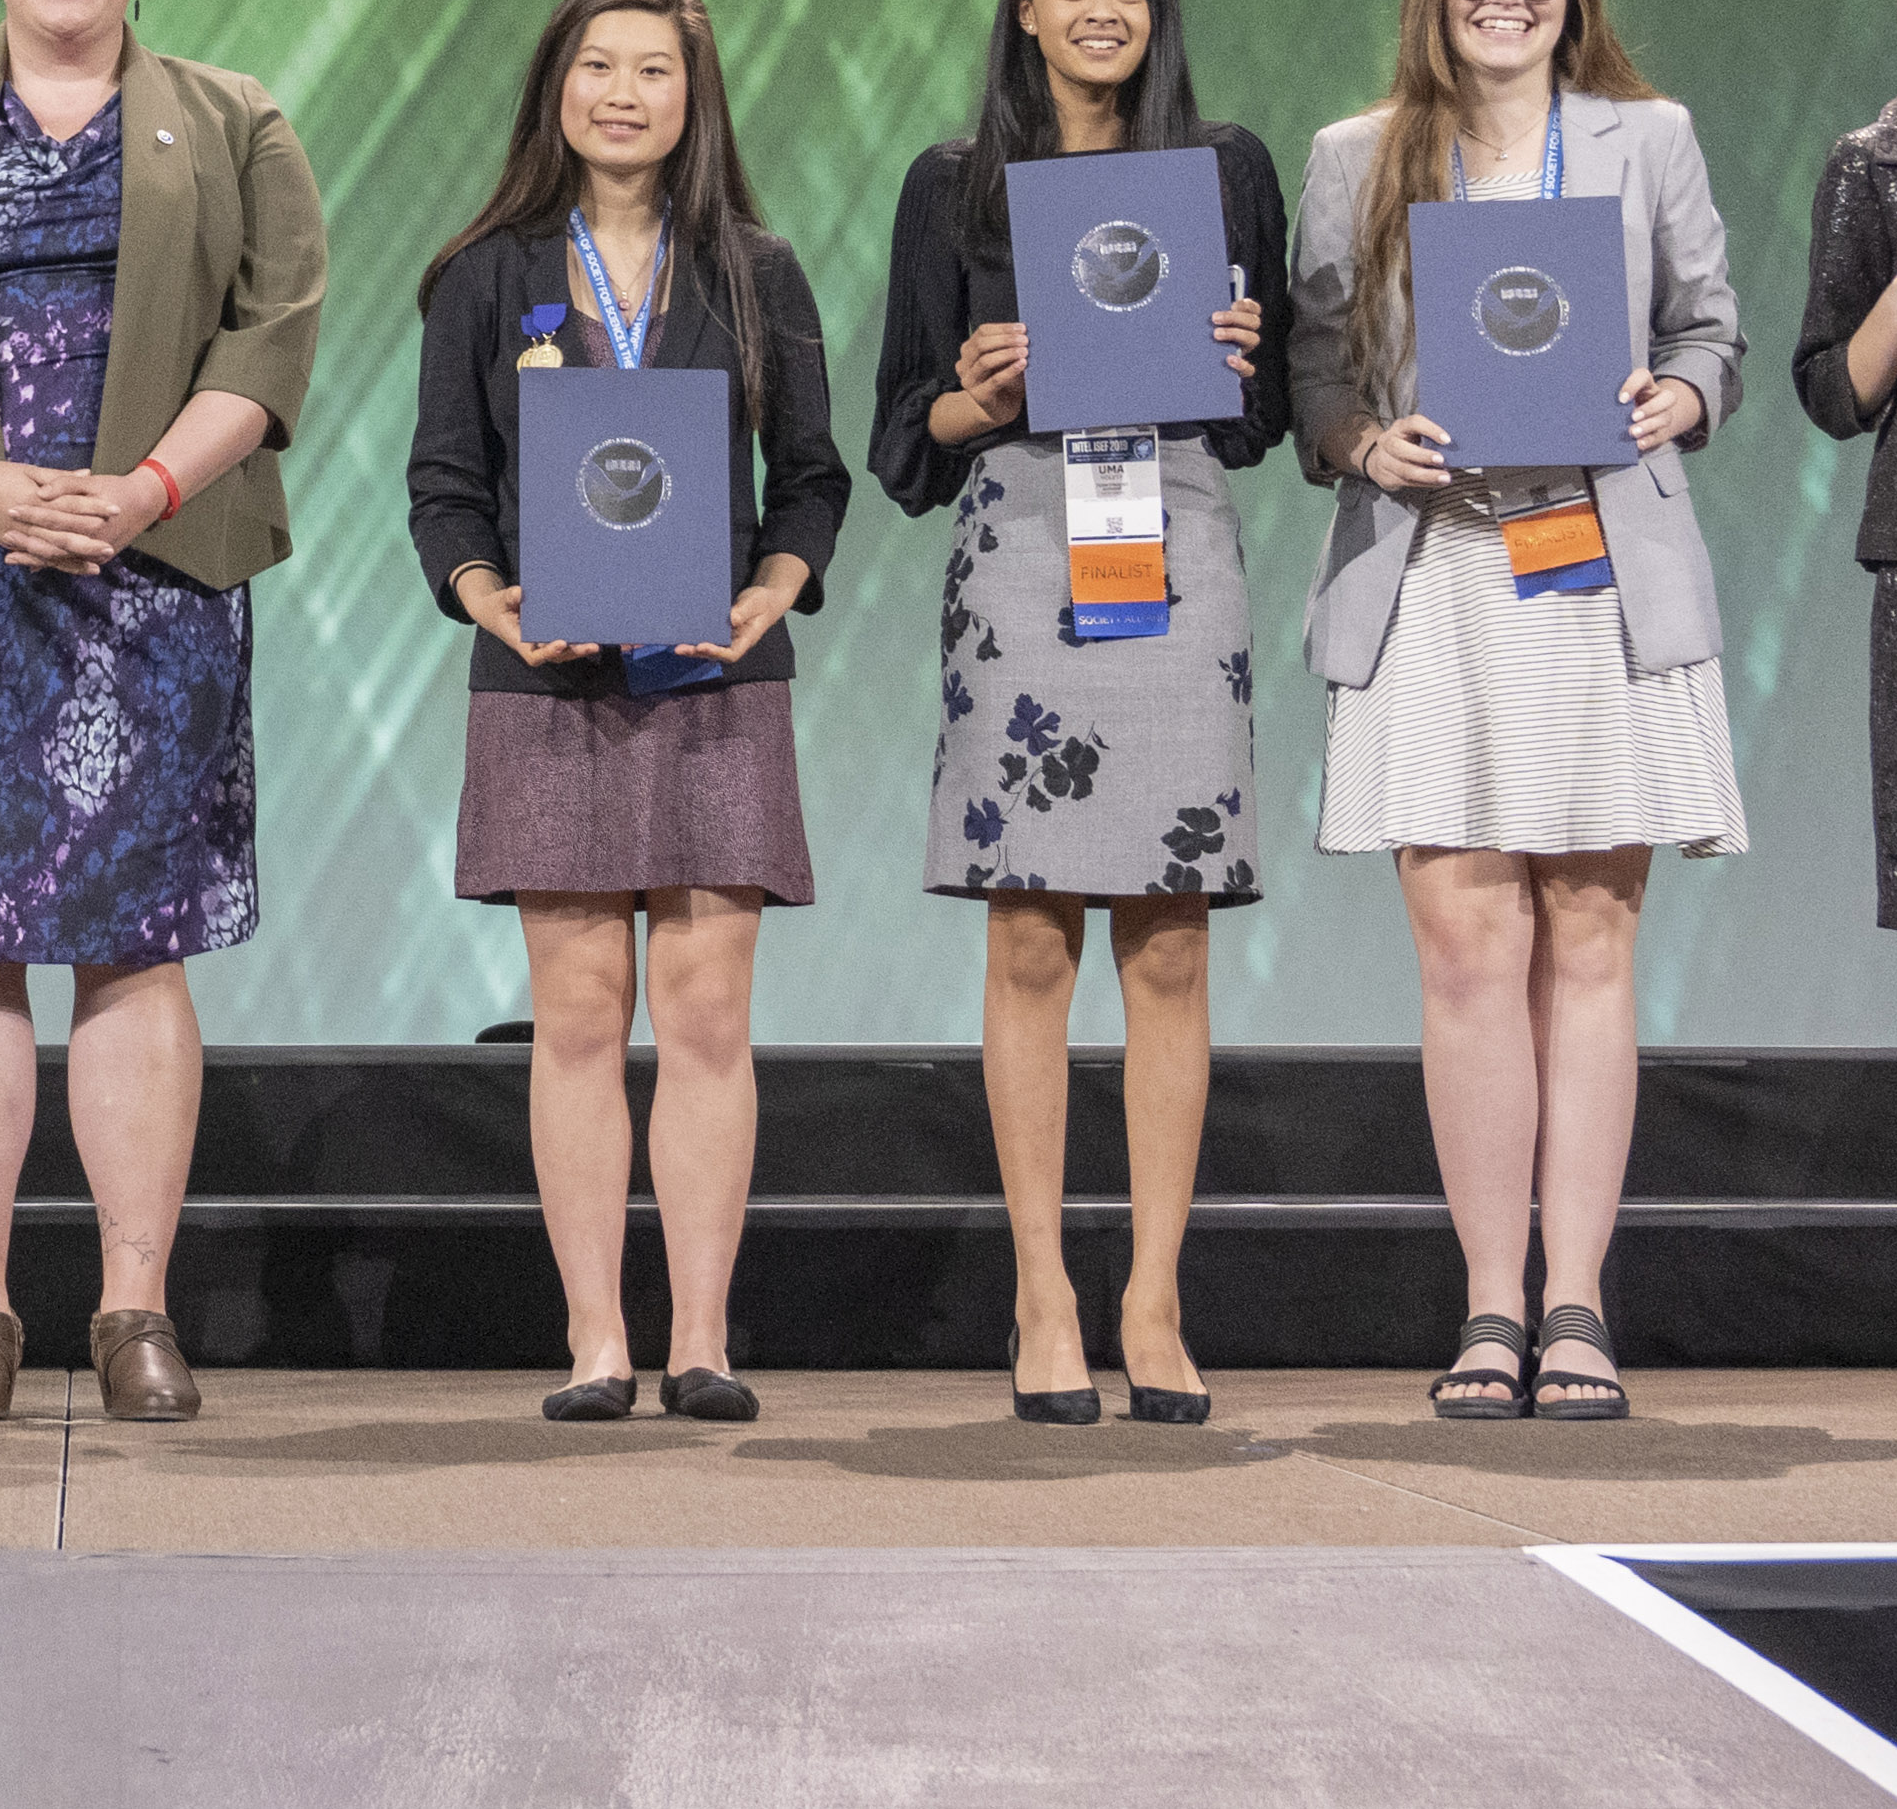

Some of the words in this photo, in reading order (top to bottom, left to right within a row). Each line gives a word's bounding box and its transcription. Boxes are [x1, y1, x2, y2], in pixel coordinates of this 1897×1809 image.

[1548, 130, 1561, 150] FOR
[1544, 150, 1558, 190] SOCIETY
[579, 238, 592, 252] OF
[585, 251, 607, 287] SOCIETY
[597, 286, 613, 307] FOR
[605, 306, 627, 343] SCIENCE
[620, 350, 636, 370] THE
[1071, 441, 1093, 454] INTEL
[1098, 465, 1125, 475] UMA
[1080, 563, 1153, 580] FINALIST
[1078, 615, 1120, 626] SOCIET
